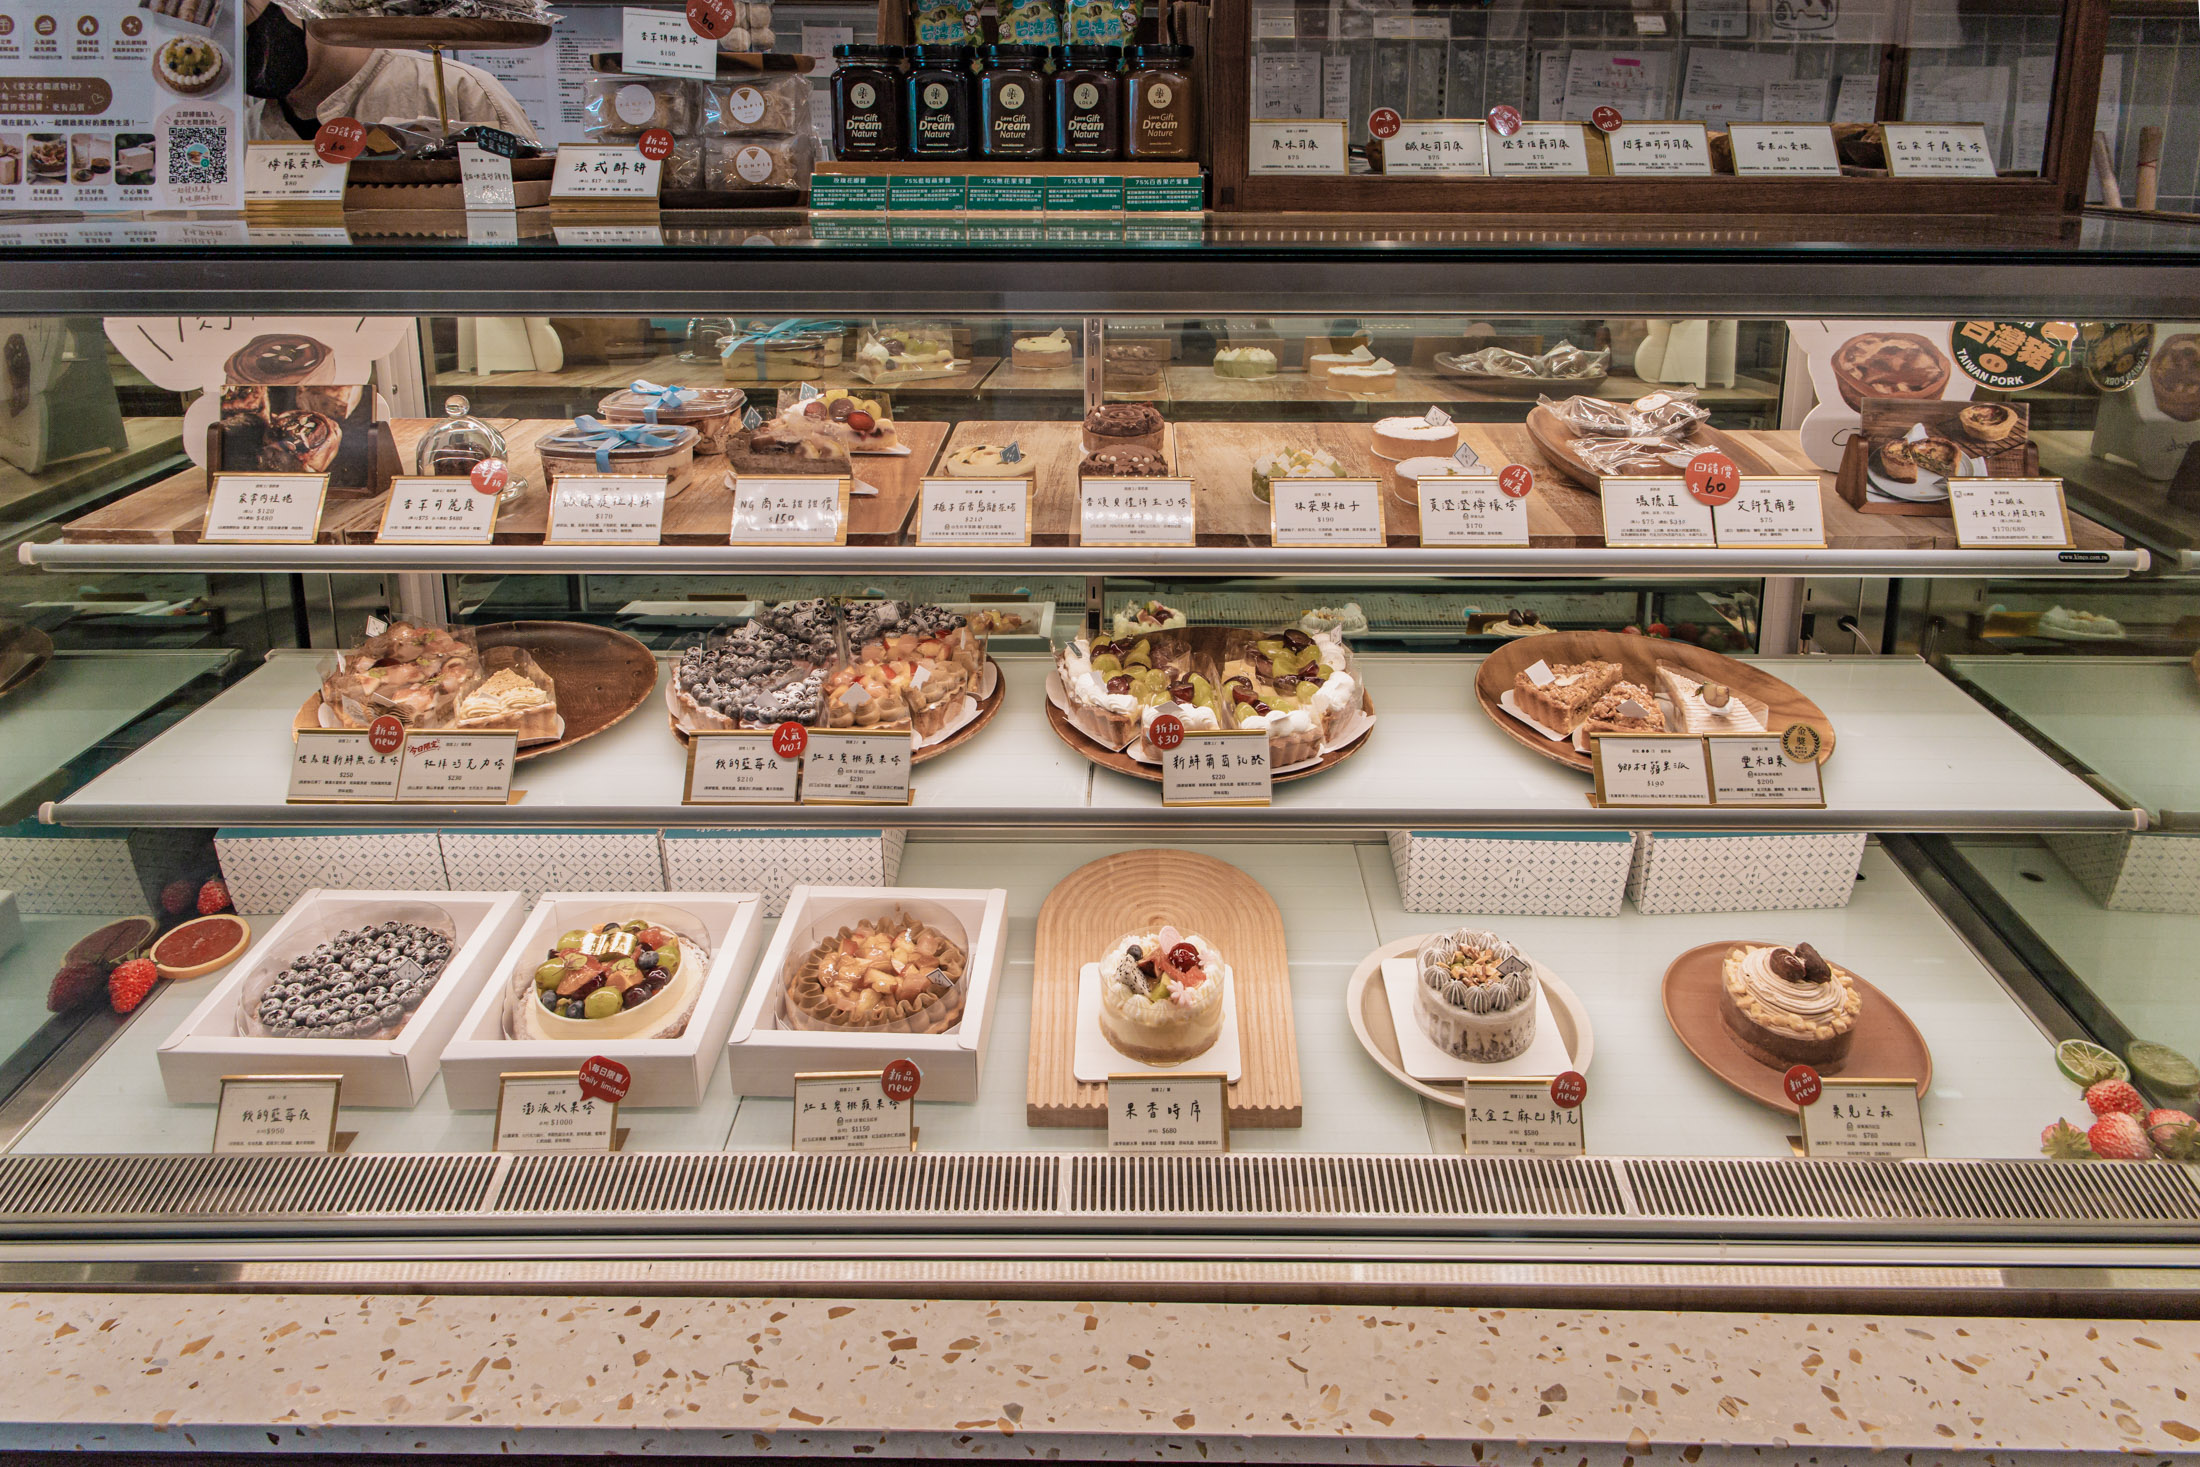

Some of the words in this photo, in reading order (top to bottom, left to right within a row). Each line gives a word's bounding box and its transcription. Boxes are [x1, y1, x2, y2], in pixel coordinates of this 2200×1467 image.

[701, 12, 715, 31] 60
[864, 113, 878, 122] Gift
[937, 114, 951, 122] Gift
[1160, 113, 1174, 121] Gift
[1375, 112, 1394, 122] 人氣
[1598, 107, 1614, 118] 人氣
[1012, 115, 1027, 123] Gift
[1086, 114, 1101, 123] Gift
[846, 120, 882, 130] Dream
[919, 121, 955, 131] Dream
[994, 121, 1031, 131] Dream
[1068, 121, 1104, 131] Dream
[1142, 119, 1178, 130] Dream
[1602, 119, 1621, 130] NO.2
[851, 129, 878, 138] Nature
[924, 130, 951, 138] Nature
[1000, 130, 1026, 138] Nature
[1073, 130, 1100, 138] Nature
[1147, 129, 1174, 137] Nature
[1377, 125, 1397, 136] NO.3
[646, 135, 668, 146] 新品
[1271, 139, 1319, 150] 原味司康
[1502, 138, 1571, 150] 橙香伯爵司康
[1623, 139, 1694, 150] 阿華田可可司康
[645, 147, 667, 155] new
[1404, 141, 1464, 152] 鹹起司司康
[574, 161, 647, 176] 法式酥餅
[1961, 321, 2056, 372] 台灣豬
[1956, 348, 1987, 381] TAIWAN
[1989, 375, 2024, 386] PORK
[1694, 462, 1733, 479] 回饋價
[1692, 483, 1700, 494] $
[1705, 476, 1726, 494] 60
[404, 498, 475, 512] 香草可麗露
[1294, 500, 1360, 512] 抹茶與柚子
[1430, 498, 1518, 513] 黃澄澄檸檬塔
[1636, 494, 1679, 508] 瑪德蓮
[1737, 499, 1795, 514] 艾許費南雪
[374, 725, 398, 736] 新品
[779, 727, 801, 741] 人氣
[1155, 723, 1180, 734] 折扣
[374, 737, 396, 746] new
[1157, 735, 1179, 745] $30
[407, 740, 440, 756] 今日限定
[779, 741, 801, 752] NO.1
[424, 758, 505, 770] 杜拜巧克力塔
[715, 758, 778, 771] 我的藍莓夜
[812, 753, 901, 766] 紅玉蜜桃蘋果塔
[1173, 753, 1266, 770] 新鮮葡萄乳酪
[1618, 761, 1690, 776] 鄉村蘋果派
[592, 1064, 624, 1083] 每日限量
[888, 1068, 913, 1082] 新品
[580, 1072, 598, 1087] Daily
[600, 1083, 626, 1097] limited
[1558, 1079, 1581, 1092] 新品
[1789, 1072, 1812, 1092] 新品
[888, 1083, 912, 1093] new
[1795, 1084, 1816, 1101] new
[1557, 1092, 1579, 1101] new
[522, 1101, 596, 1116] 澎派水果塔
[803, 1098, 900, 1113] 紅玉蜜桃蘋果塔
[242, 1108, 311, 1123] 我的藍莓夜
[1126, 1100, 1201, 1123] 果香時序
[1469, 1108, 1578, 1125] 黑金芝麻巴斯克
[1832, 1104, 1893, 1119] 栗見之森
